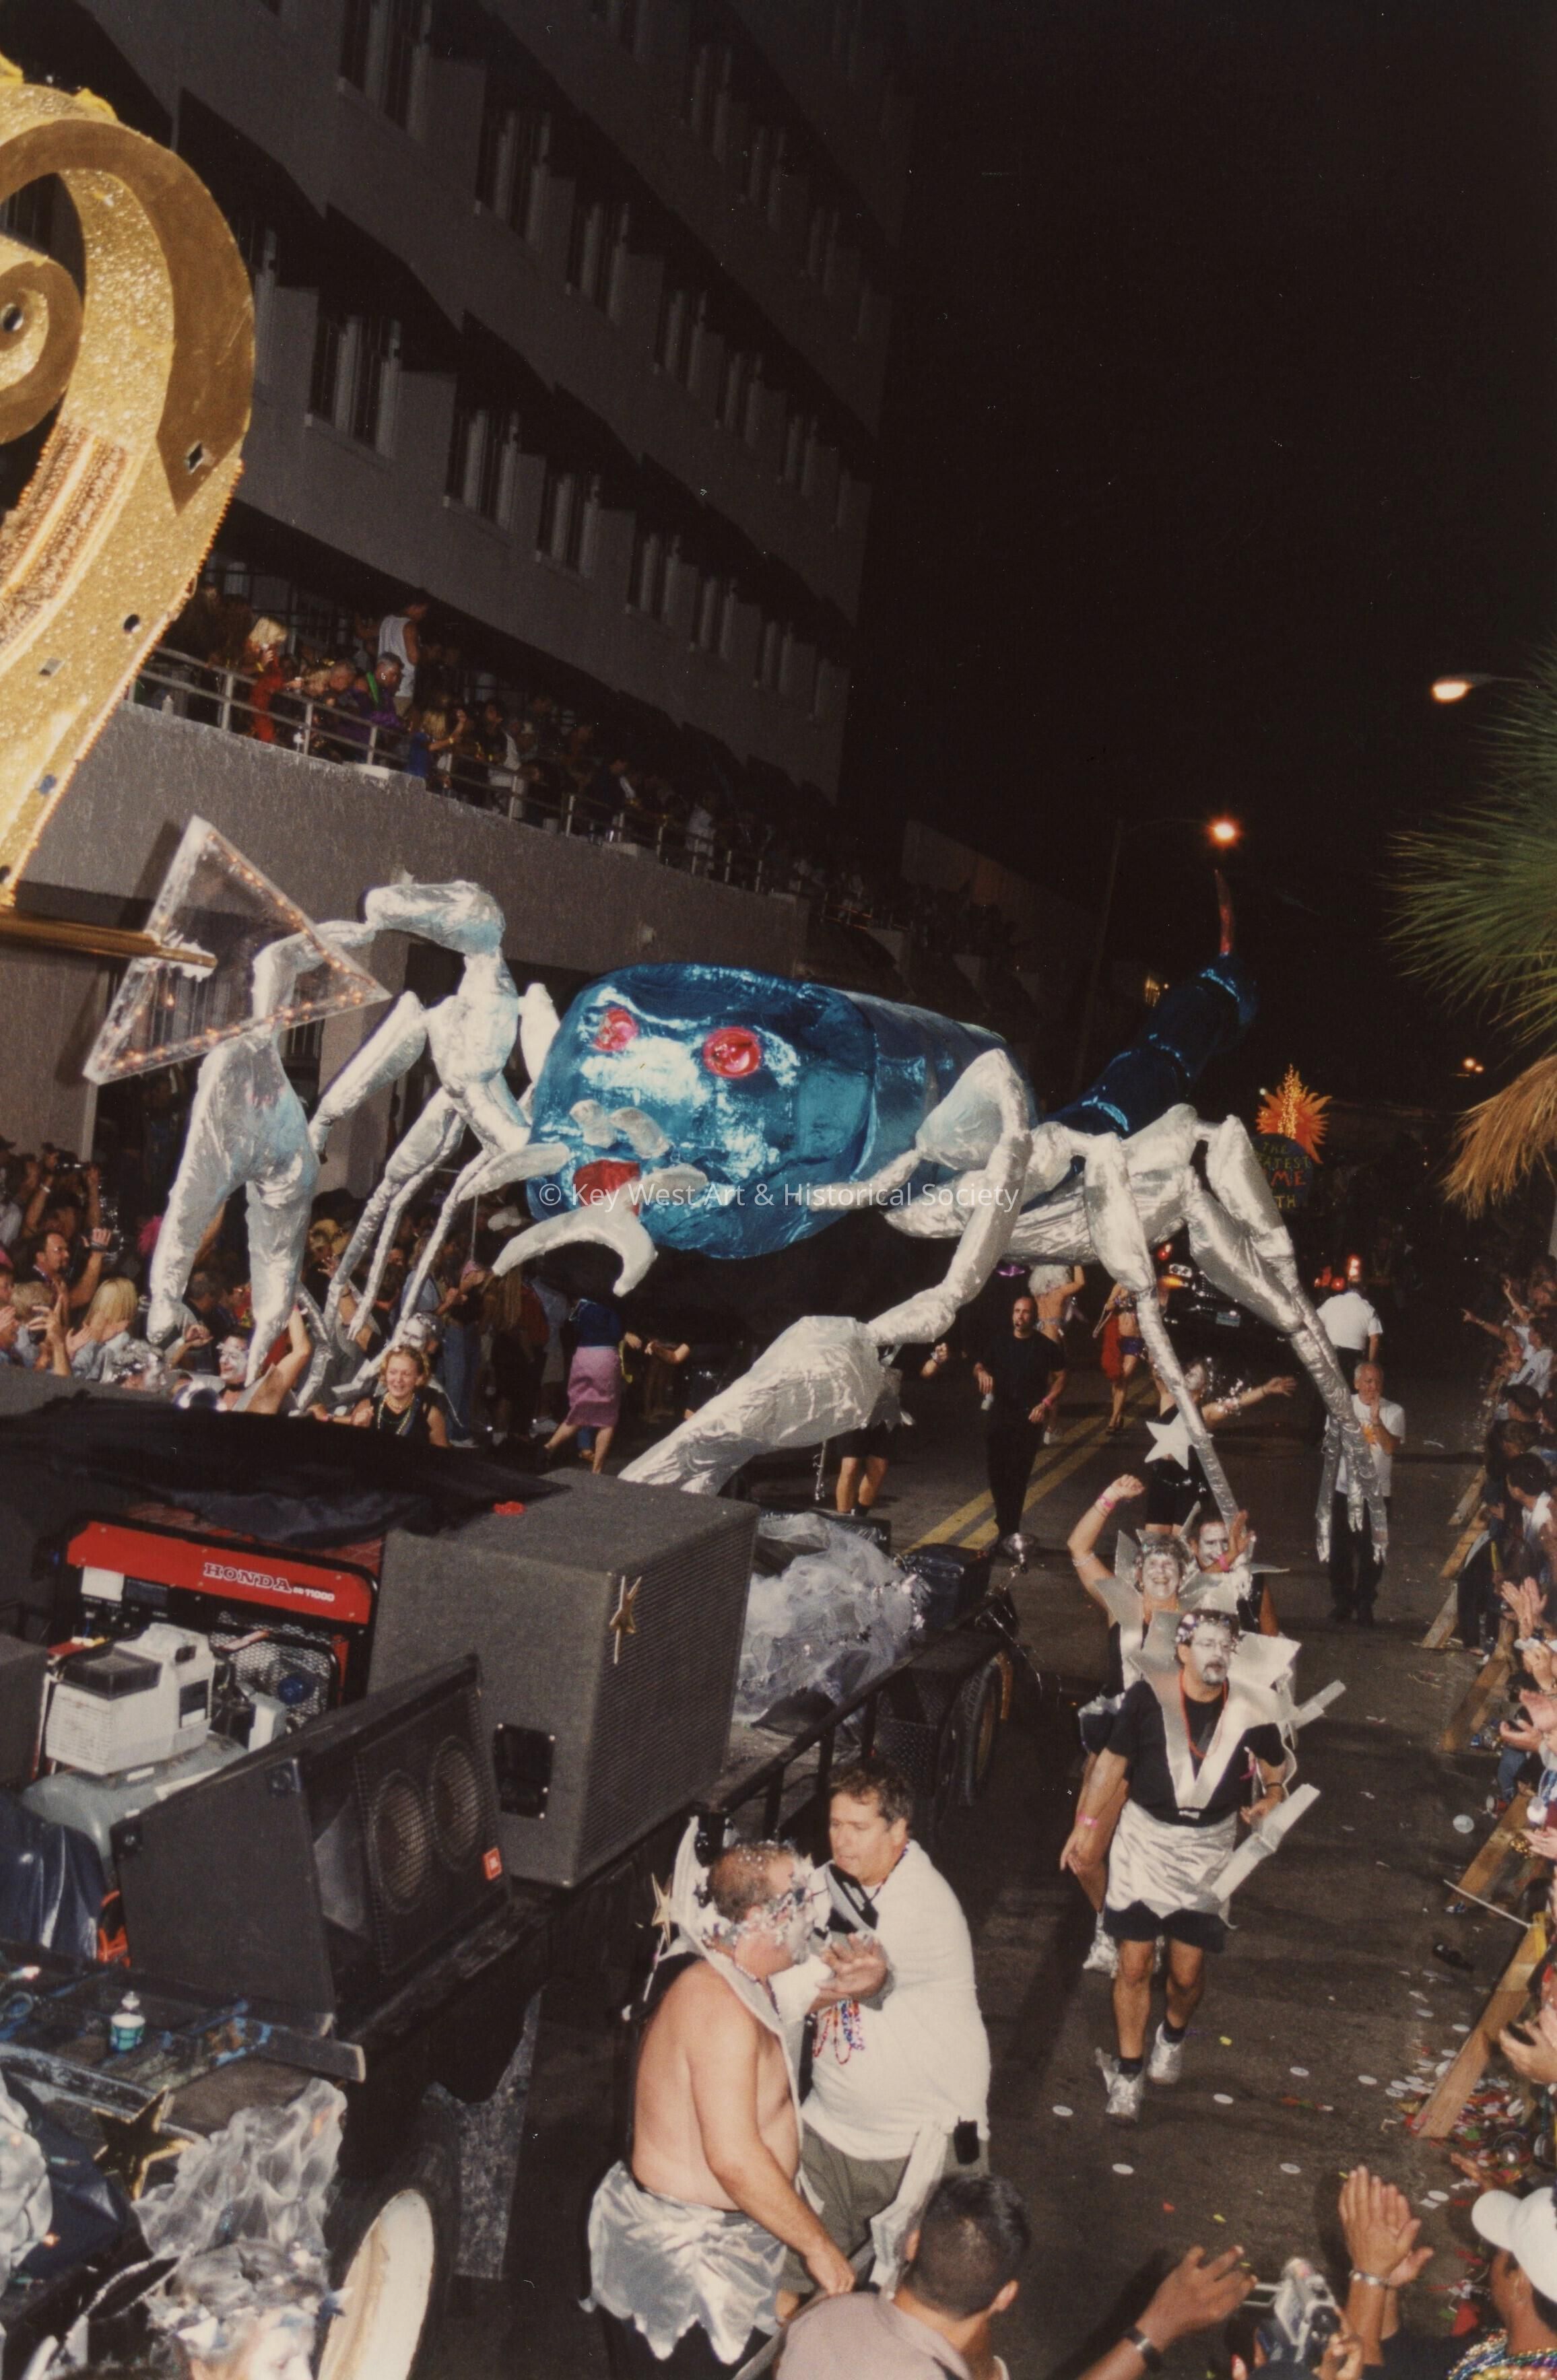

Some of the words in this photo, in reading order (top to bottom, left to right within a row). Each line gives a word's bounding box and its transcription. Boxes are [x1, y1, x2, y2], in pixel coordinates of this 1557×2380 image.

[1258, 1155, 1311, 1170] ATEST
[1265, 1170, 1306, 1187] ME
[1275, 1195, 1296, 1209] TH
[203, 1562, 292, 1594] HONDA
